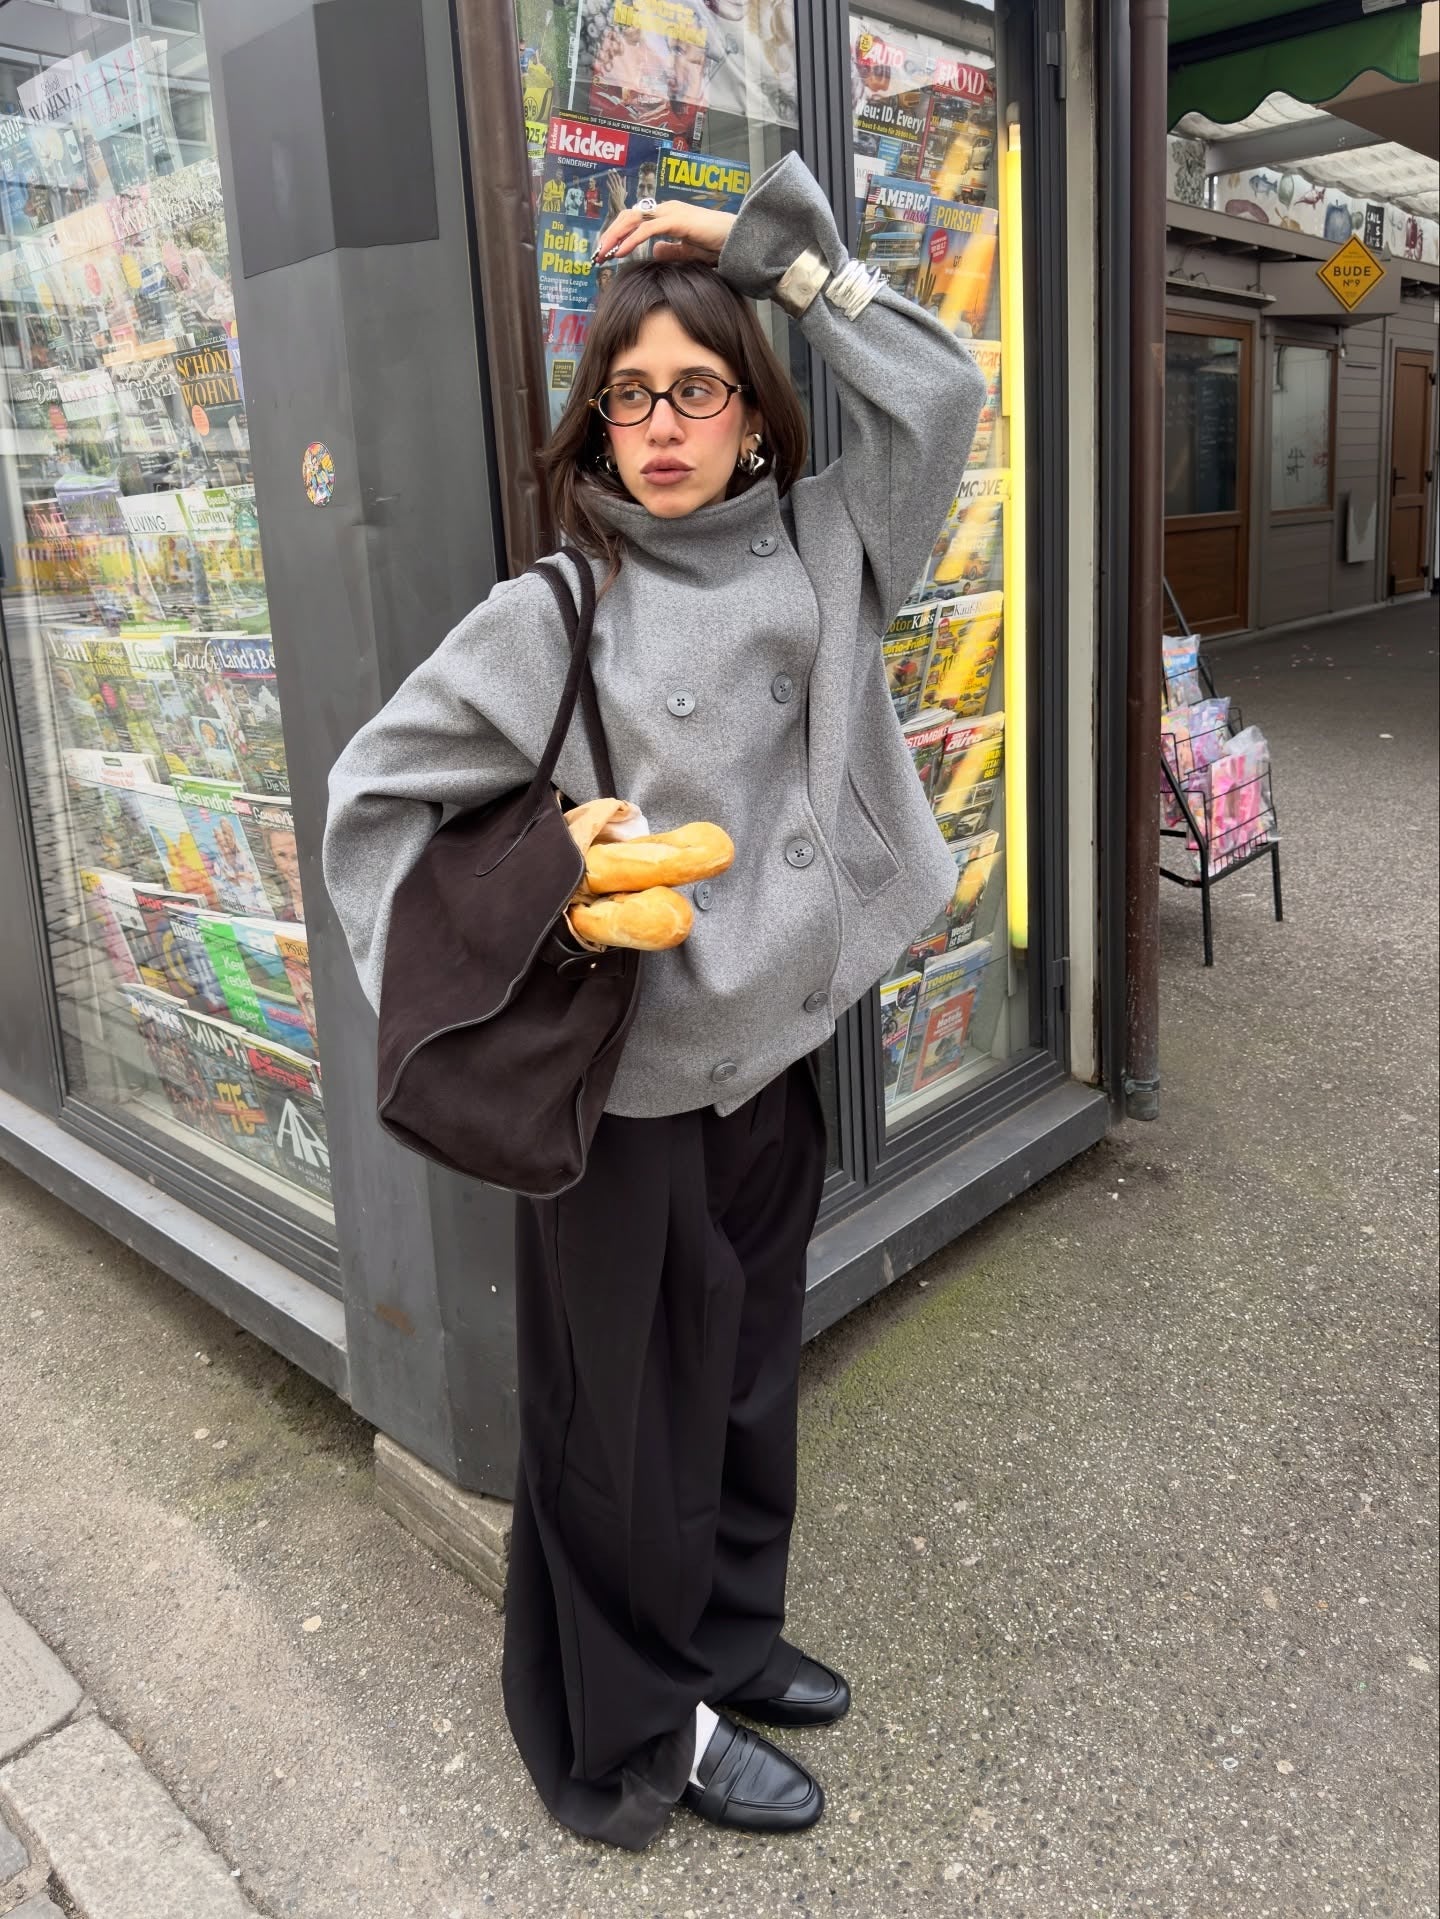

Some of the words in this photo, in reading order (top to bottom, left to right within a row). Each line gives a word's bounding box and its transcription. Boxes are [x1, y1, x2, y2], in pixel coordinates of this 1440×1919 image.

[558, 124, 625, 160] kicker
[557, 156, 598, 170] SONDERHEFT
[552, 220, 564, 231] Die
[543, 229, 588, 254] heiße
[541, 252, 592, 276] Phase
[1333, 266, 1371, 277] BUDE
[128, 514, 168, 532] LIVING
